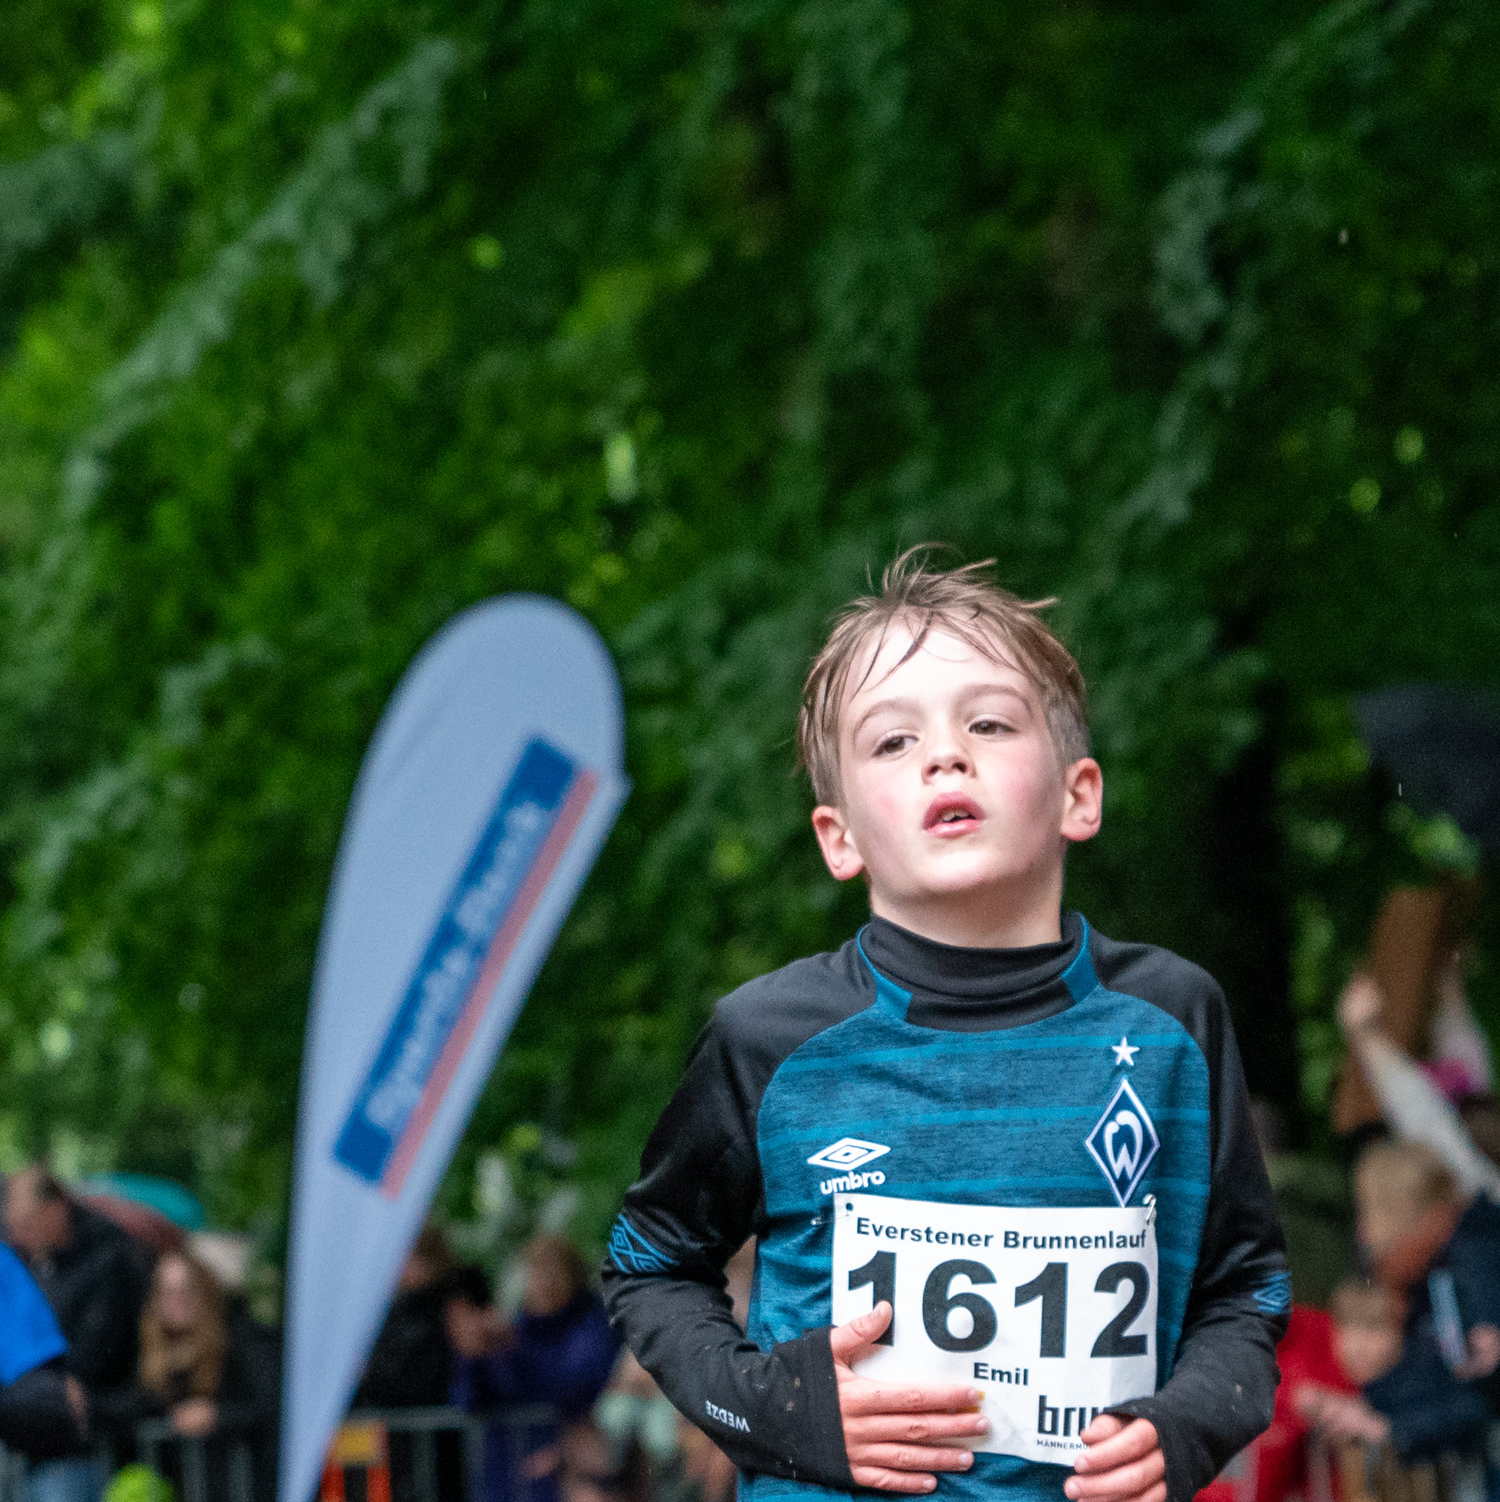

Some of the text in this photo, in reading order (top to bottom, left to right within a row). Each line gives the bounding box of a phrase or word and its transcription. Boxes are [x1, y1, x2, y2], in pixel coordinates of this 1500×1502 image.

[820, 1171, 886, 1195] umbro
[856, 1217, 1147, 1249] Everstener Brunnenlauf
[847, 1250, 1151, 1359] 1612
[973, 1362, 1029, 1386] Emil
[705, 1400, 751, 1433] WEDZE
[1037, 1394, 1112, 1437] bru
